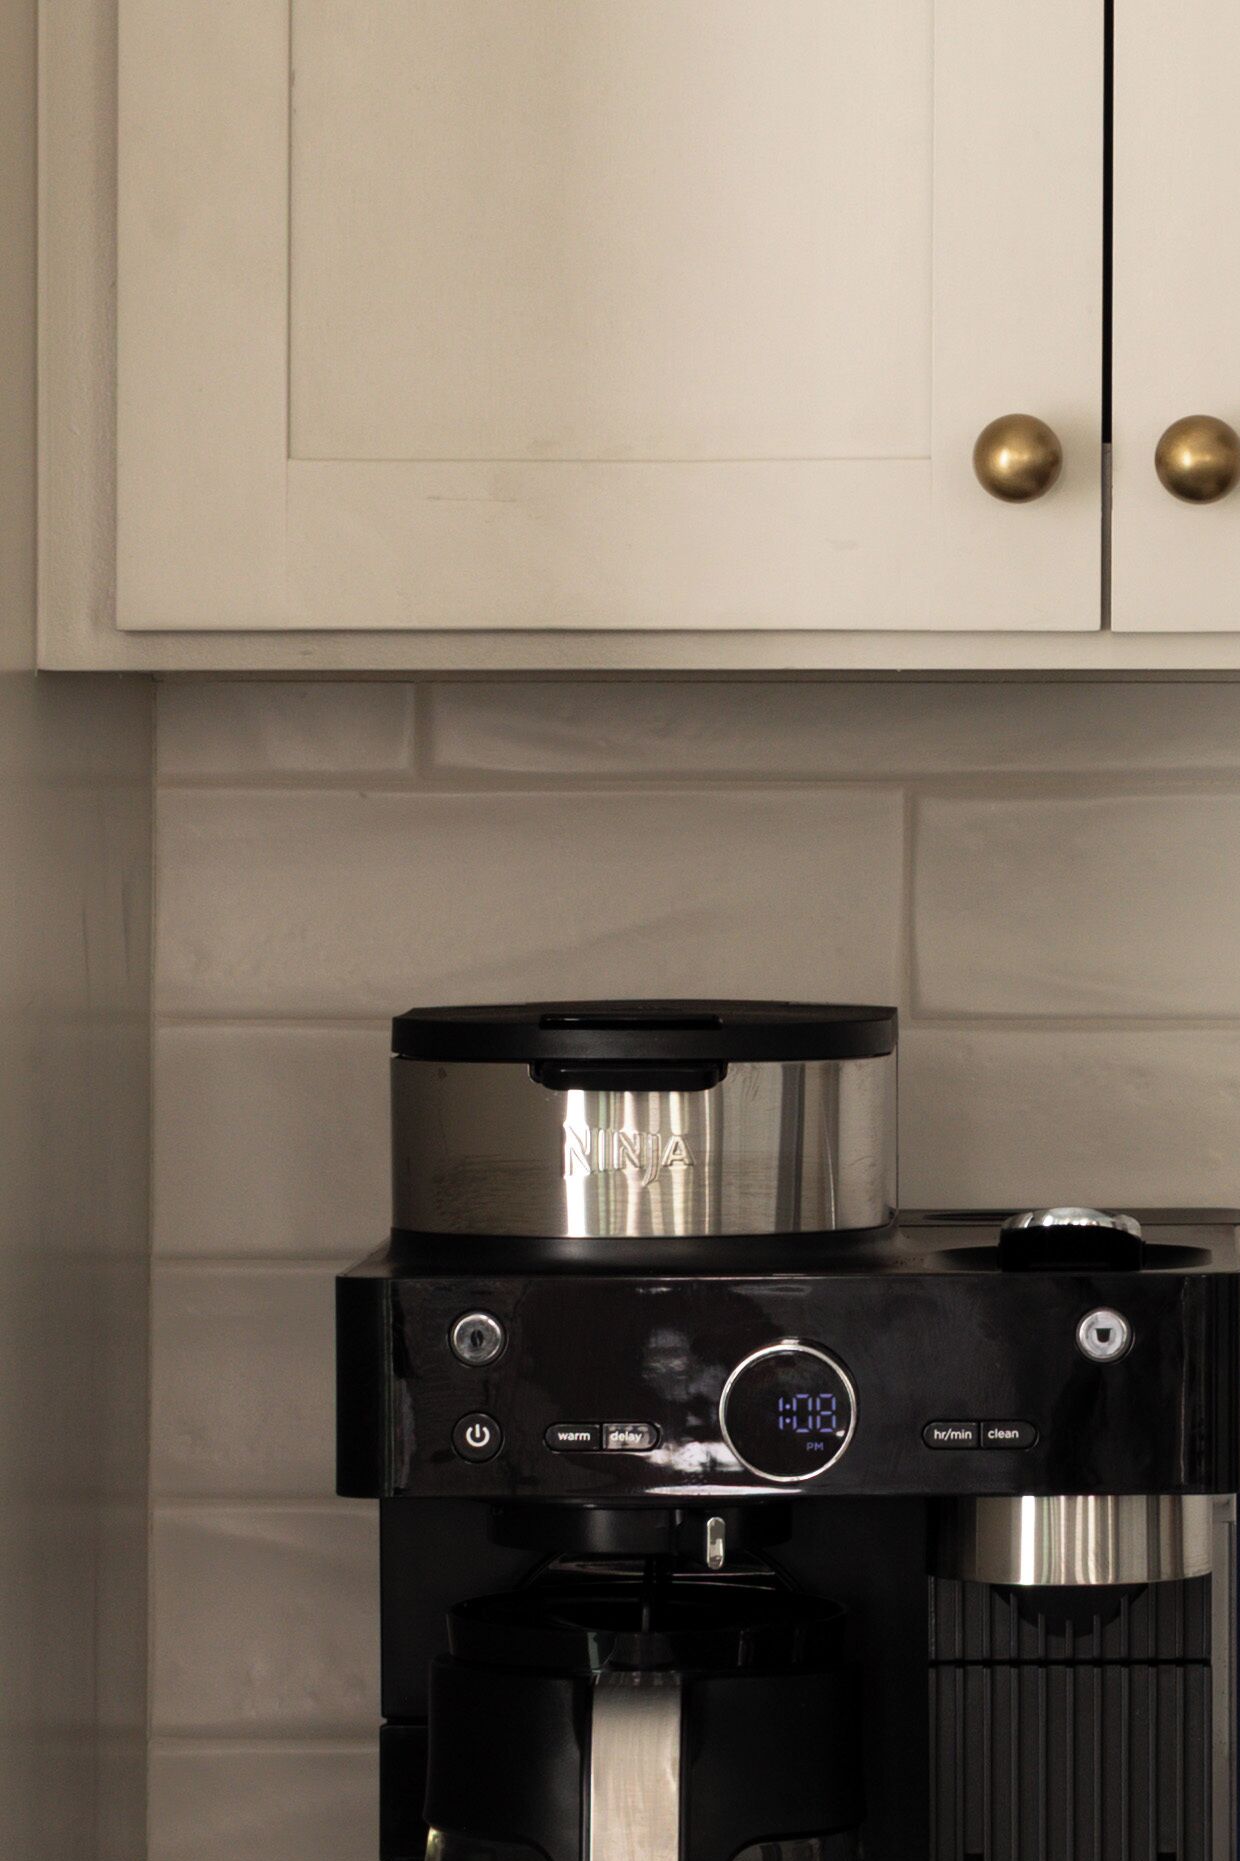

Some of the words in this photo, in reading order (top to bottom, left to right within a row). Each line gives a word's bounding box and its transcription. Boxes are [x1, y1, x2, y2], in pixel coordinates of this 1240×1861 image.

[563, 1122, 695, 1187] NINJA
[779, 1393, 836, 1433] 1:08
[558, 1431, 591, 1441] warm
[609, 1430, 642, 1444] delay
[933, 1428, 973, 1441] hr/min
[987, 1428, 1020, 1439] clean
[806, 1441, 824, 1451] PM
